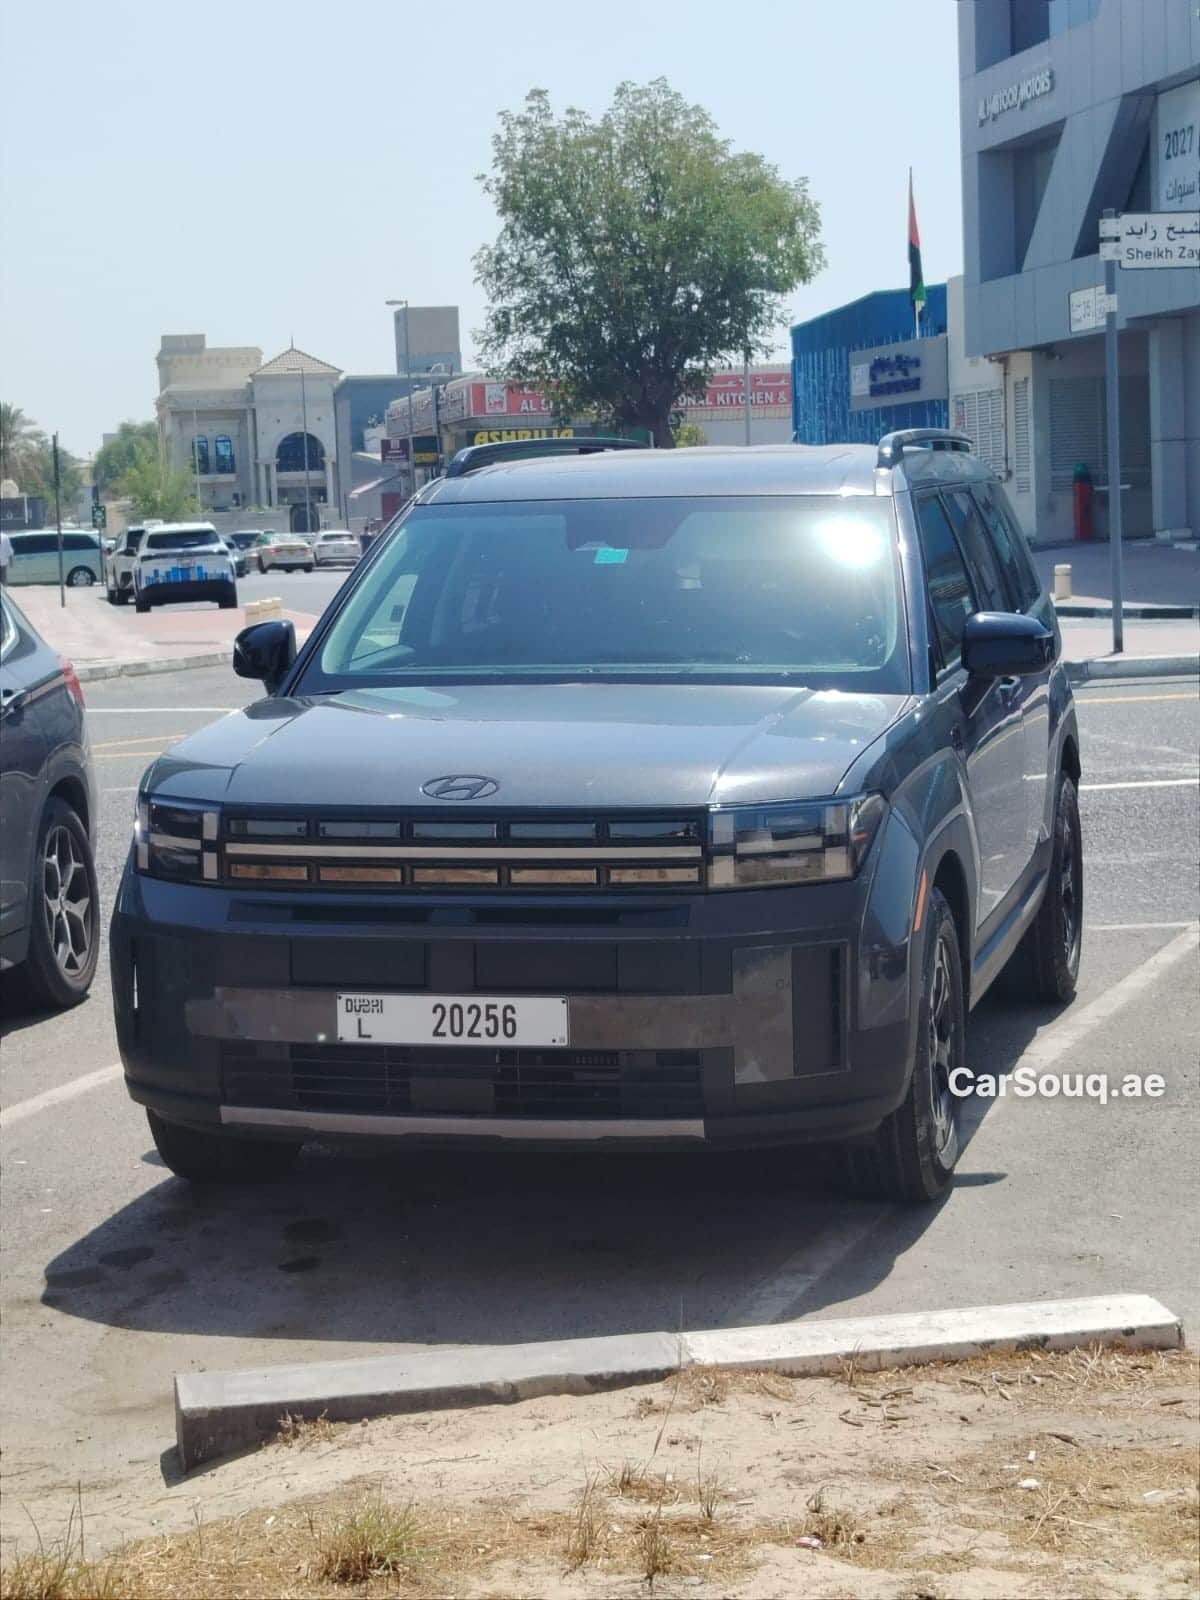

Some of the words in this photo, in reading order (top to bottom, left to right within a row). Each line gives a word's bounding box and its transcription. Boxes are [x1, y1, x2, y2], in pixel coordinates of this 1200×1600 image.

[1019, 70, 1051, 103] MOTORS
[1164, 124, 1194, 160] 2027
[1125, 220, 1157, 241] زايد
[1125, 247, 1173, 261] Sheikh
[715, 390, 774, 406] KITCHEN
[345, 998, 384, 1014] DUBAI
[358, 1018, 372, 1039] L
[431, 1003, 518, 1039] 20256
